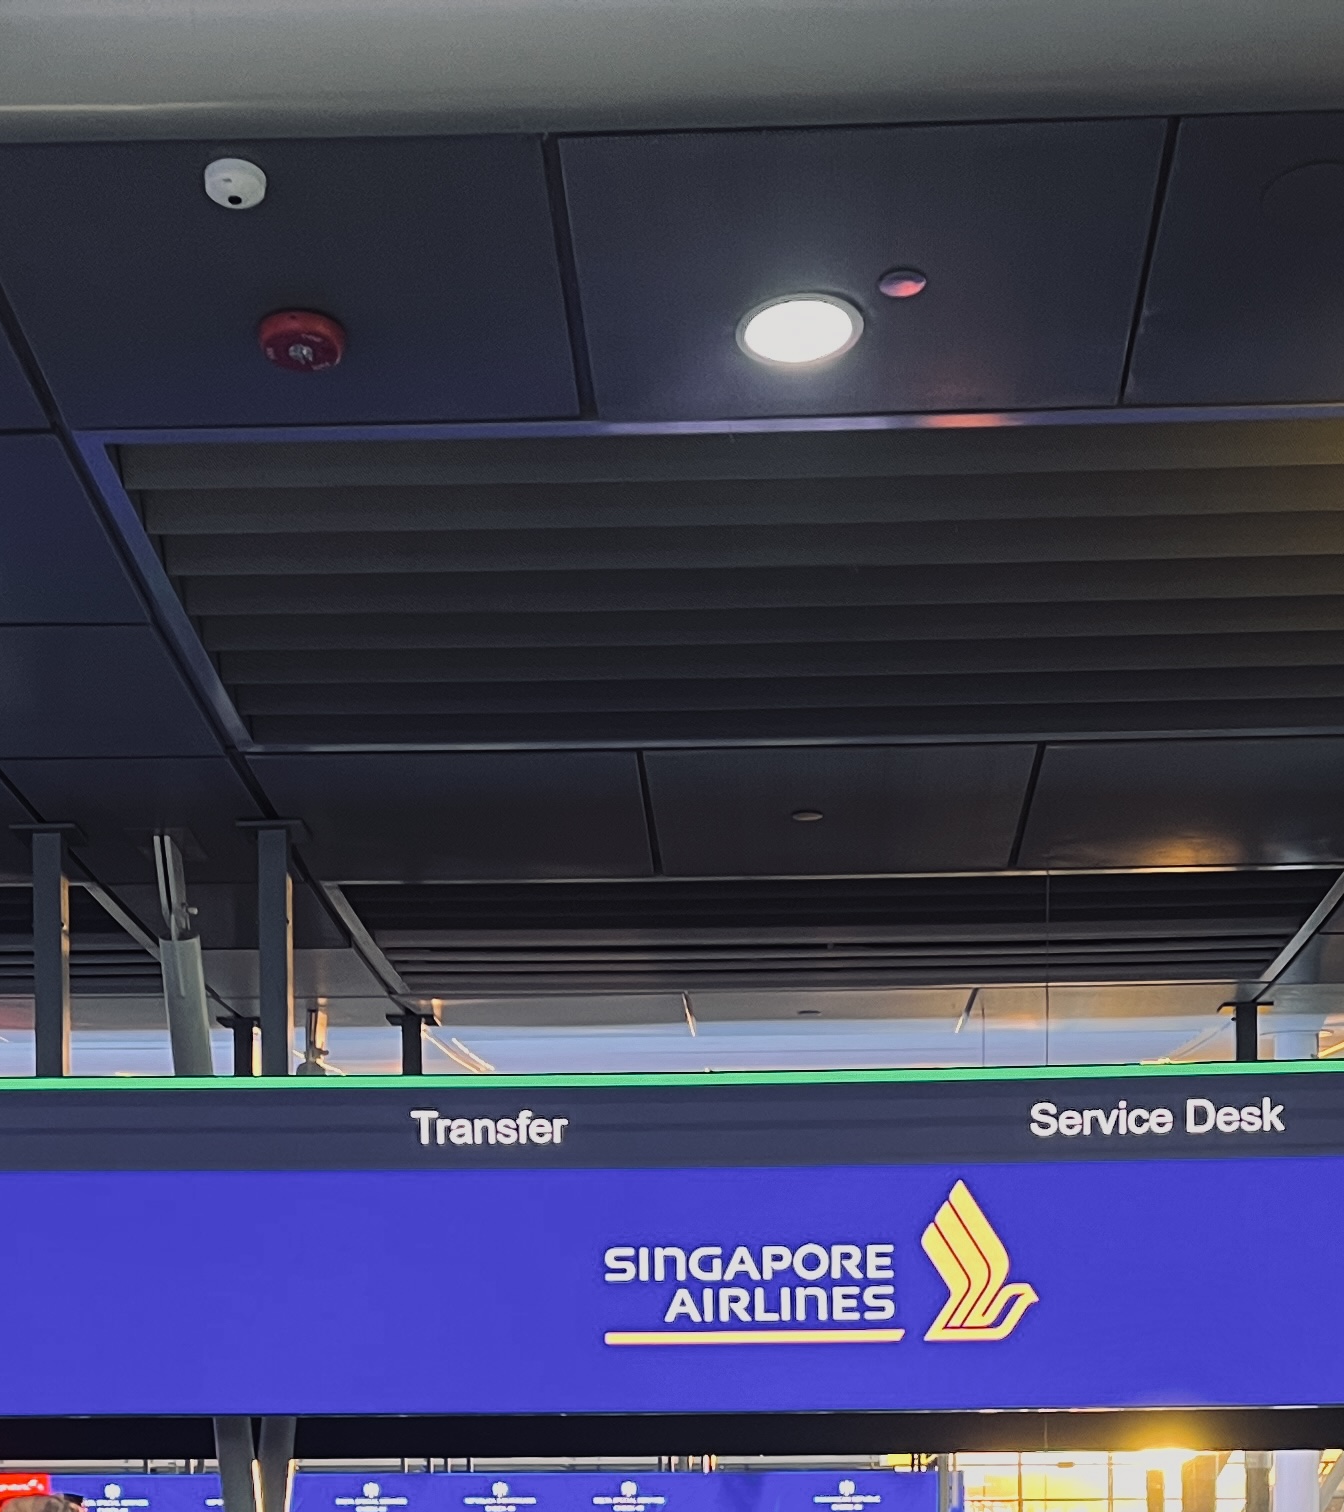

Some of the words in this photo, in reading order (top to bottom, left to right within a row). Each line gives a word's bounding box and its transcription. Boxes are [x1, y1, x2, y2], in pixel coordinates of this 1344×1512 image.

[409, 1109, 569, 1145] Transfer
[1029, 1100, 1174, 1137] Service
[1185, 1096, 1286, 1134] Desk
[604, 1242, 895, 1282] SINGAPORE
[663, 1285, 895, 1323] AIRLINES
